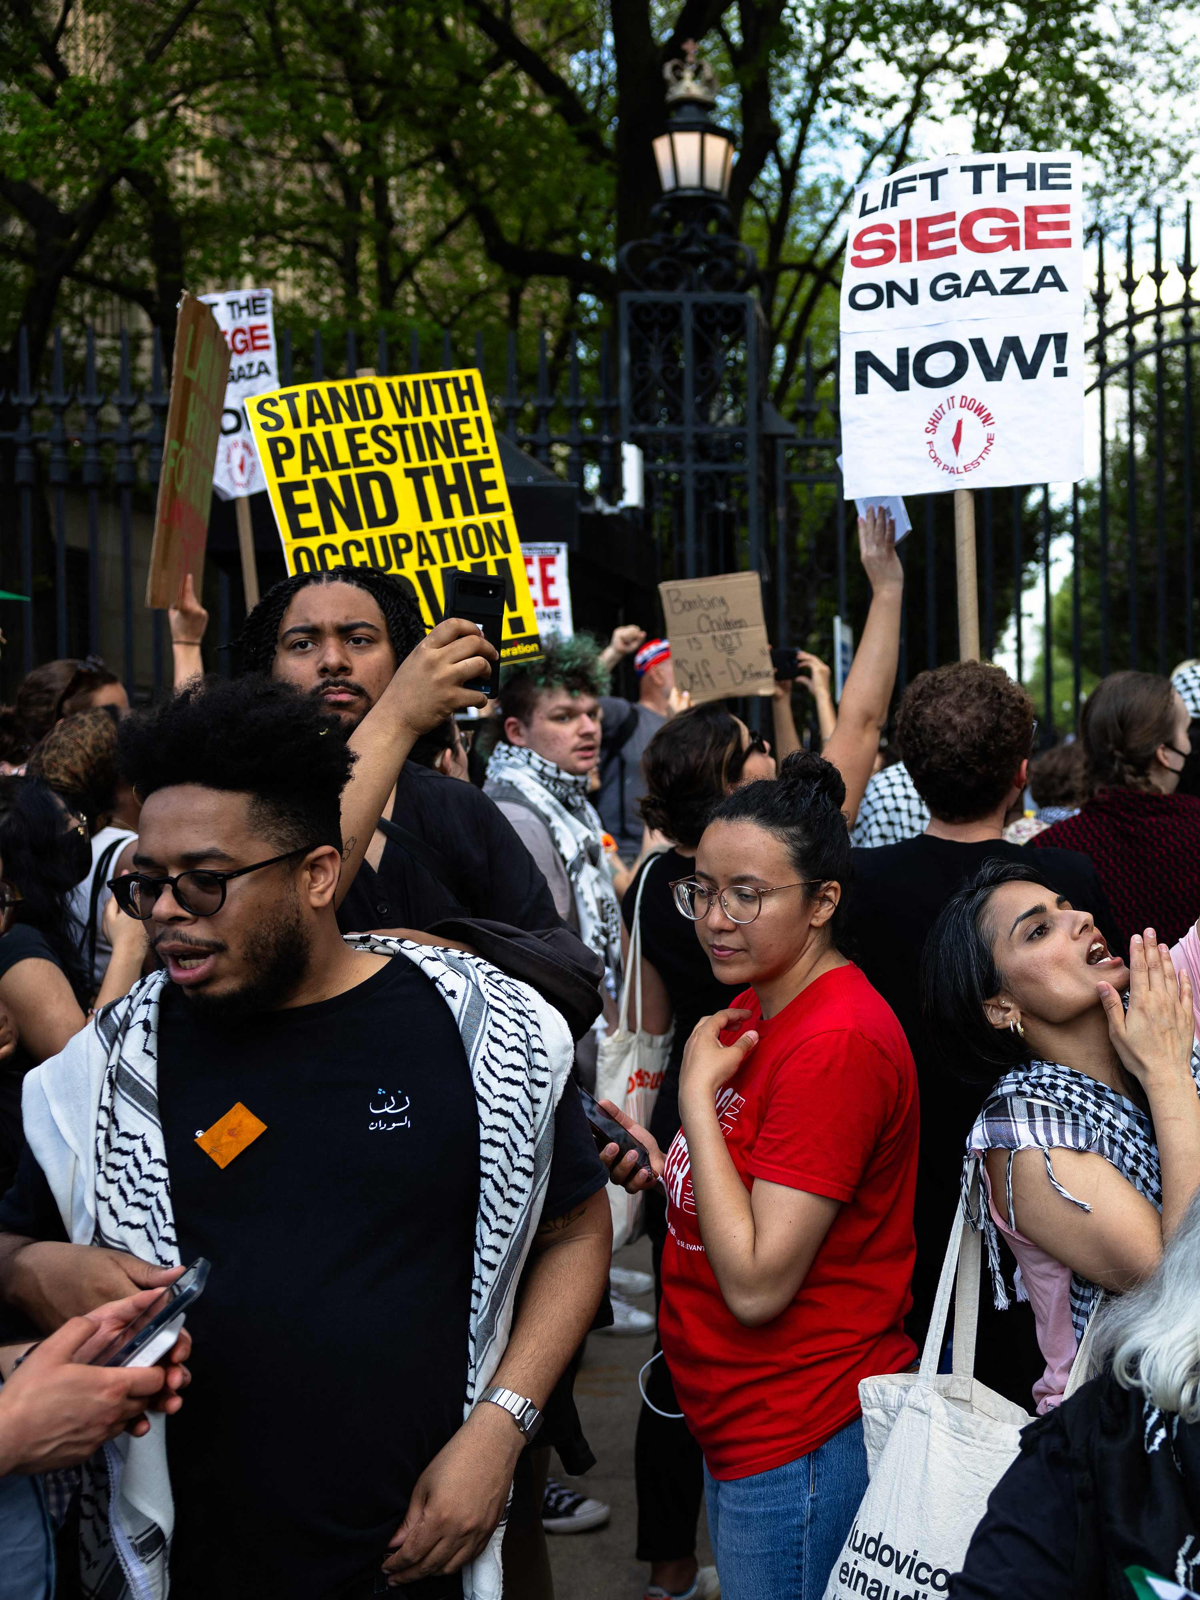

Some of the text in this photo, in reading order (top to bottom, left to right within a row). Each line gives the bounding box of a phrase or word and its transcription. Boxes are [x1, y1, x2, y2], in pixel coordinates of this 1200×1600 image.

[857, 161, 1073, 219] LIFT THE
[850, 203, 1073, 269] SIEGE
[227, 296, 268, 320] THE
[848, 264, 1070, 312] ON GAZA
[854, 331, 1069, 395] NOW!
[256, 382, 384, 433] STAND
[385, 374, 480, 420] WITH
[925, 394, 996, 436] SHUT IT DOWN!
[266, 415, 491, 479] PALESTINE!
[926, 432, 995, 476] FOR PALESTINE
[277, 469, 400, 540] END
[403, 458, 506, 523] THE
[711, 630, 744, 653] NOT
